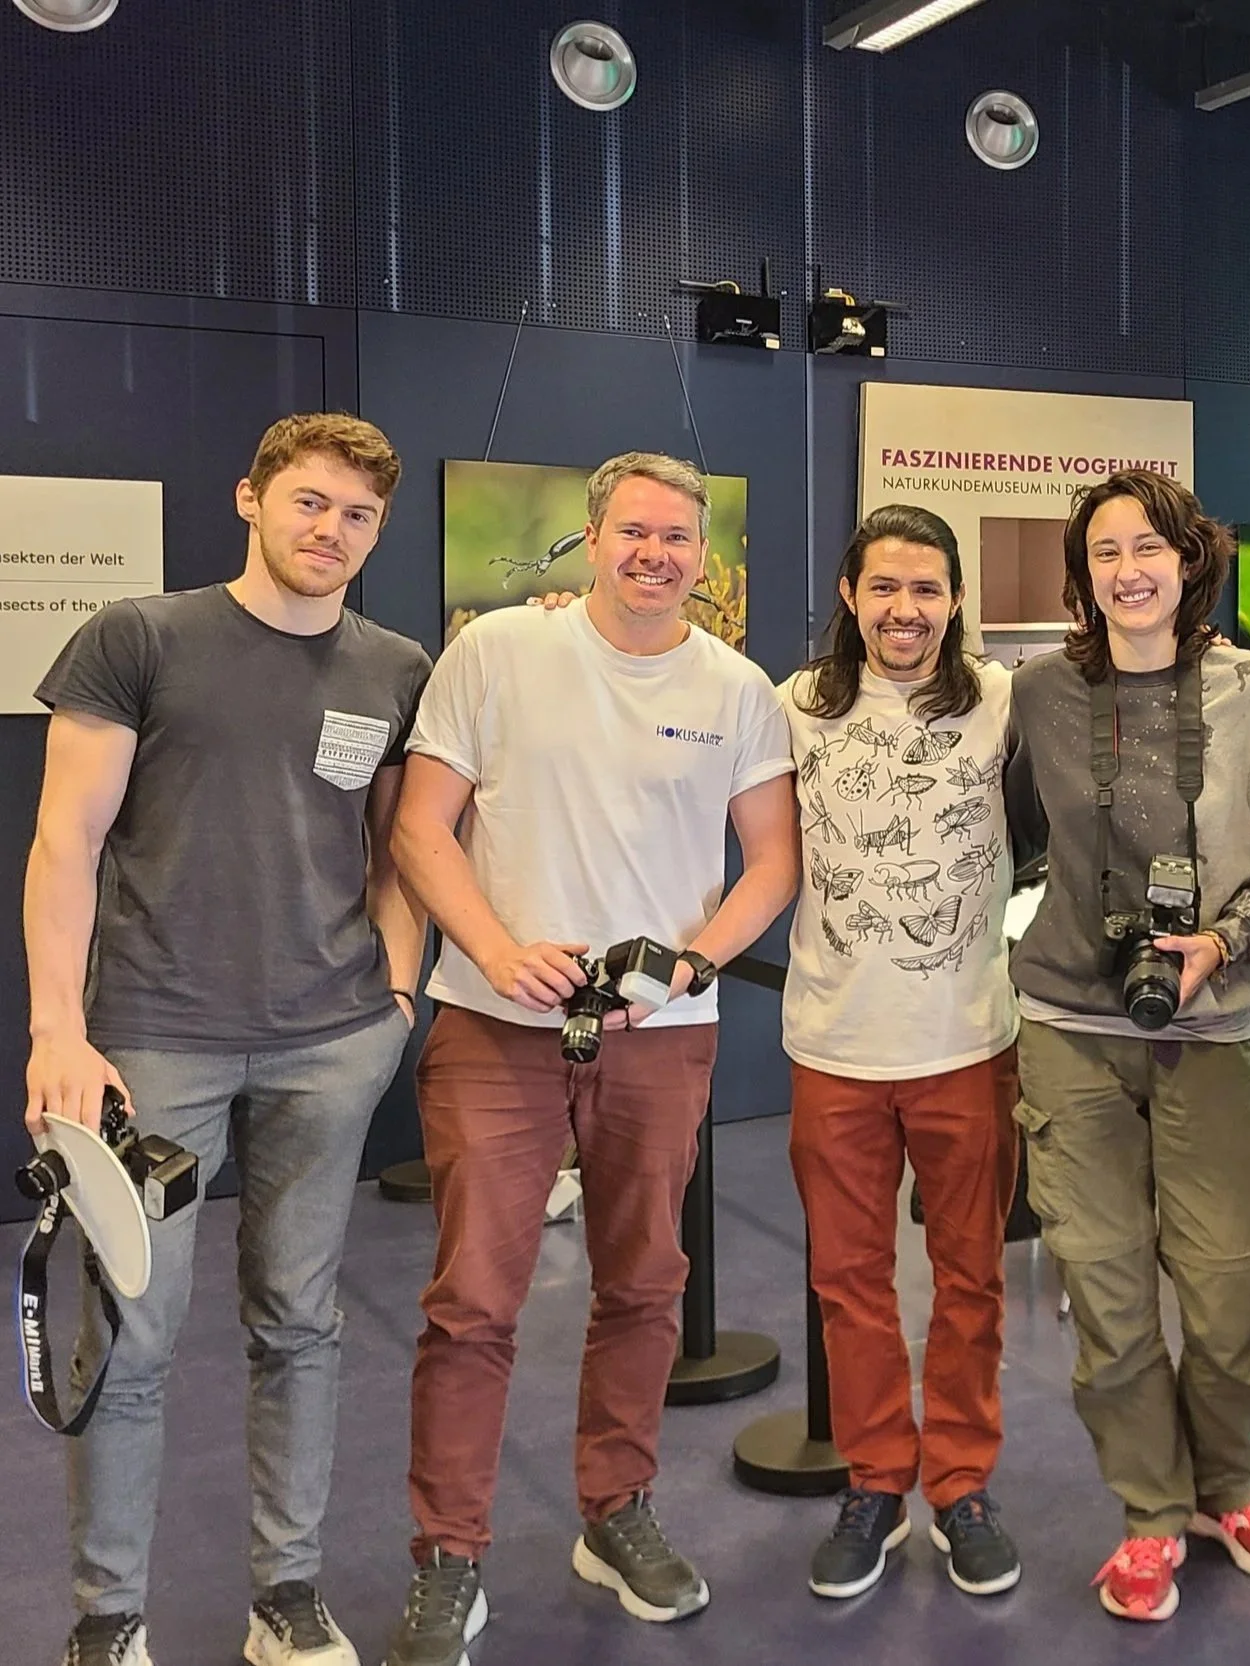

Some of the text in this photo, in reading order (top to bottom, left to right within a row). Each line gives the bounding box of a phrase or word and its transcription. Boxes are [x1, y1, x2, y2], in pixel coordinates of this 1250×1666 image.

[881, 448, 1053, 474] FASZINIERENDE
[882, 476, 1042, 495] NATURKUNDEMUSEUM
[1046, 482, 1061, 496] IN
[0, 551, 125, 566] sekten der Welt
[0, 599, 45, 612] sects
[49, 598, 67, 612] of
[71, 598, 98, 612] the
